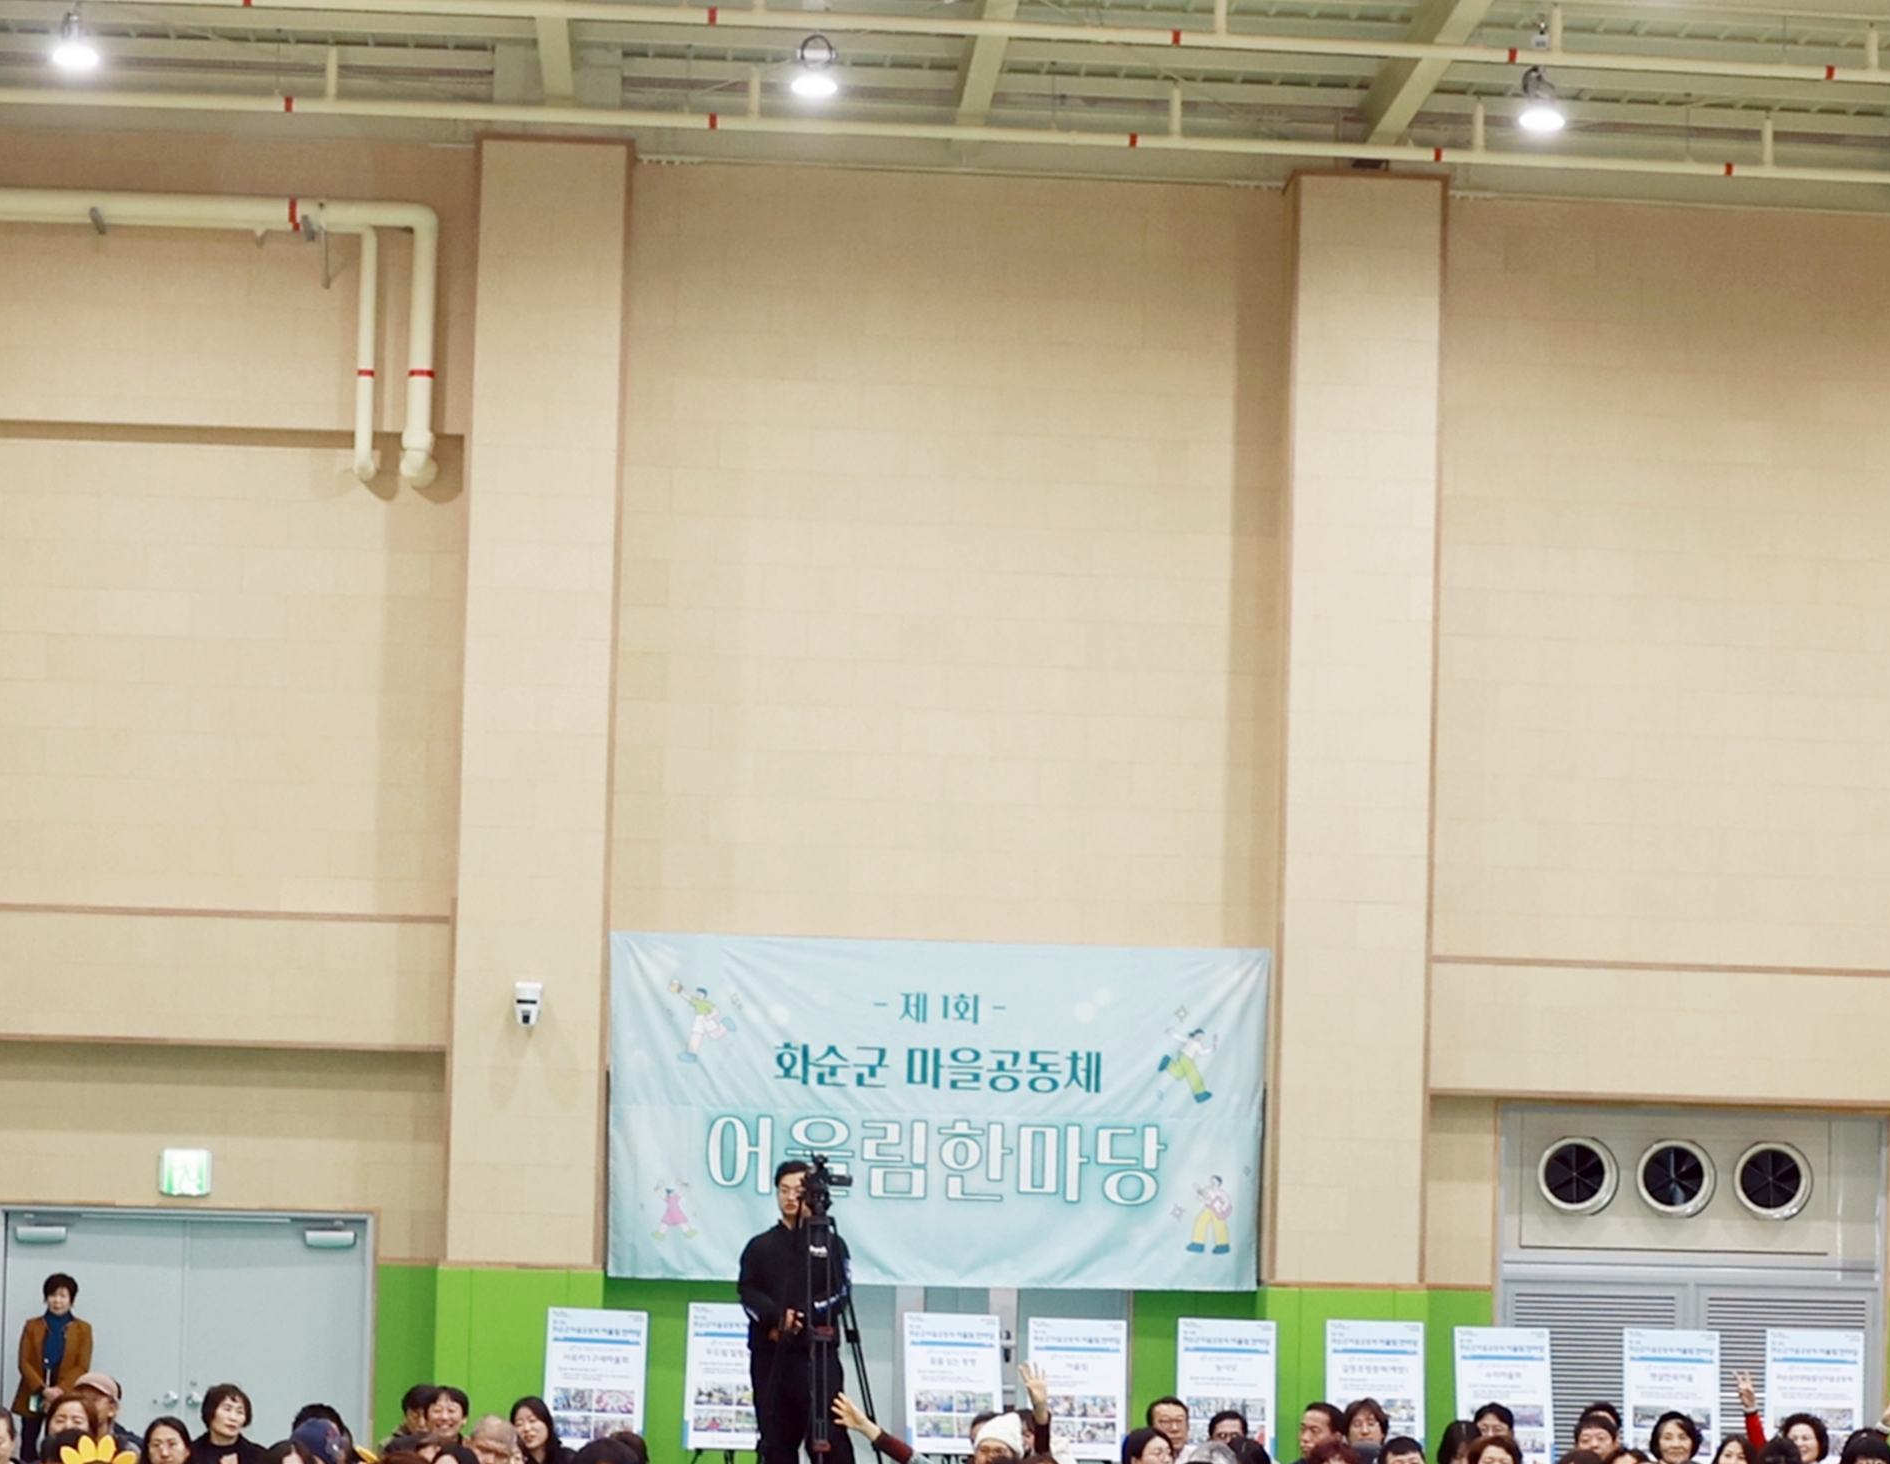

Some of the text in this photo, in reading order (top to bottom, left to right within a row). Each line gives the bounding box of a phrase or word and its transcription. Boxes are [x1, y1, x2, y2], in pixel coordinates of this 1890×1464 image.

[775, 1042, 1101, 1093] 화순군 마을공동체
[706, 1114, 1167, 1206] 어울림한마당
